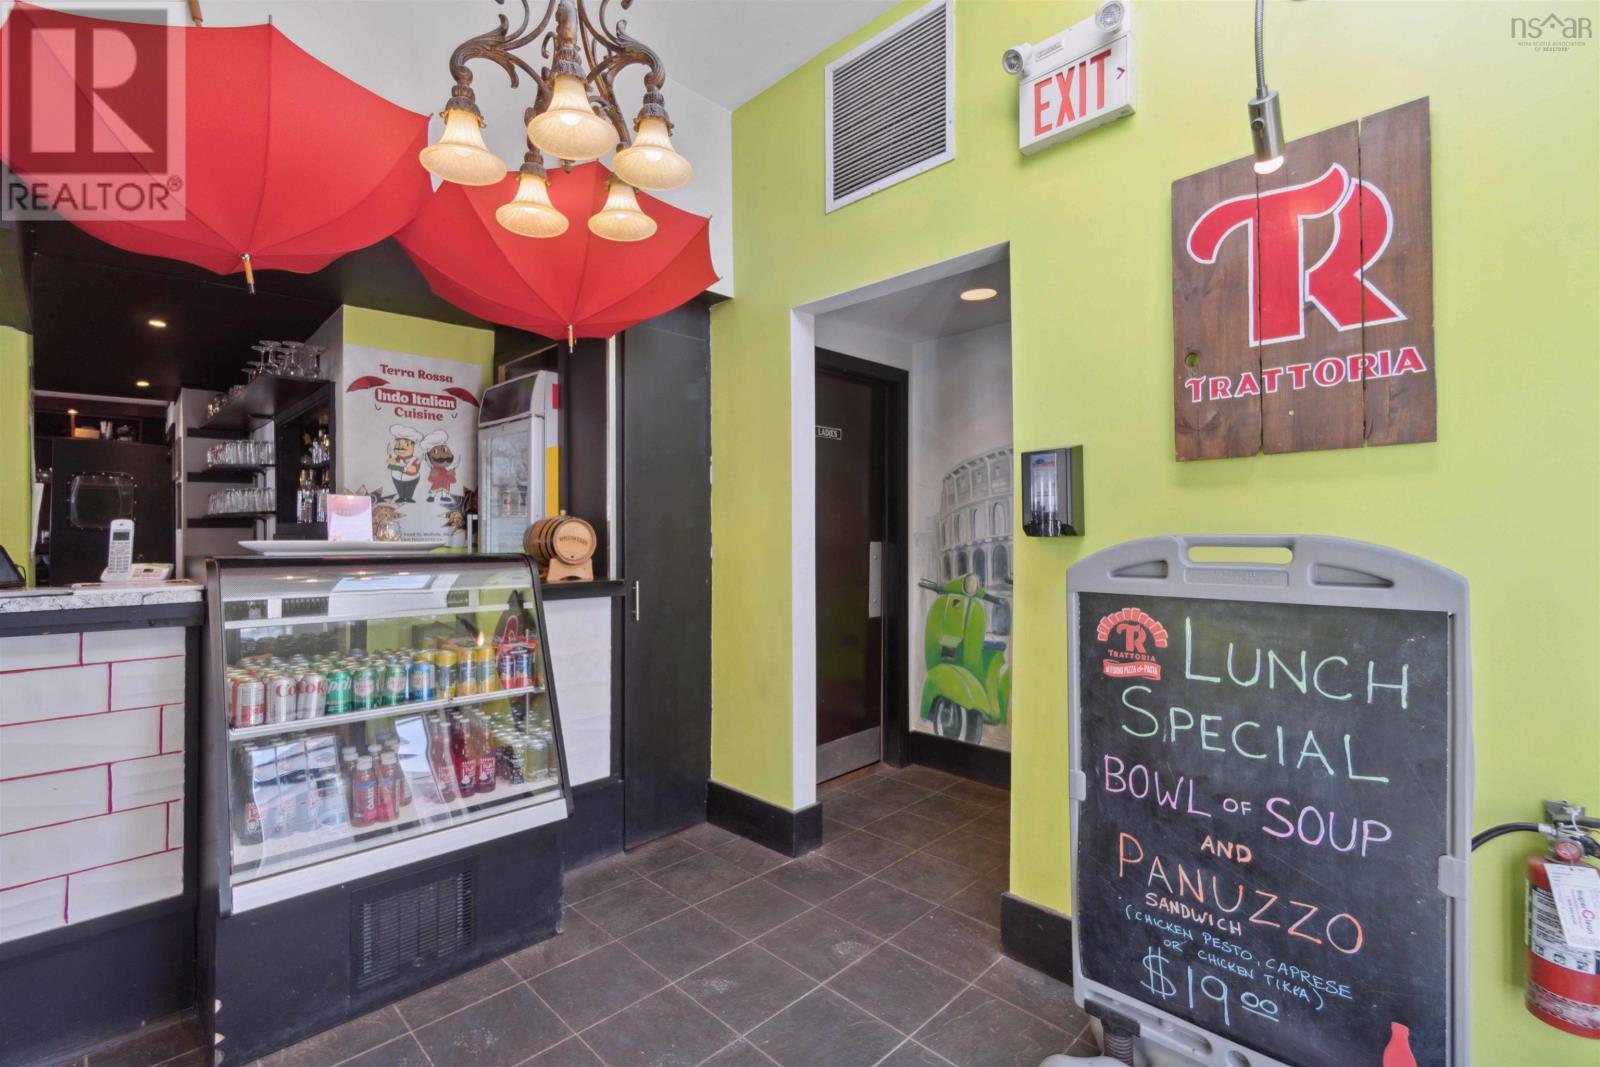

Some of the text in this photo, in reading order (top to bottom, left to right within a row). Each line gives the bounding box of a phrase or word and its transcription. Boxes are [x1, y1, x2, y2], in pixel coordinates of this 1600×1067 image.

[1033, 48, 1112, 137] EXIT
[379, 363, 454, 383] Terra Rossa
[1185, 346, 1428, 403] TRATTORIA
[377, 388, 455, 409] Indo Italian
[394, 406, 444, 422] Cuisine
[817, 428, 838, 438] LADIES
[1107, 648, 1157, 662] TRATTORIA
[1184, 615, 1409, 710] LUNCH
[1121, 684, 1390, 784] SPECIAL
[1103, 753, 1393, 858] BOWL OF SOUP
[1200, 834, 1253, 863] AND
[1118, 831, 1365, 955] PANUZZO
[1144, 891, 1243, 937] SANDWICH
[1163, 938, 1184, 952] OR
[1197, 948, 1255, 980] CHICKEN
[1265, 957, 1354, 1000] CAPRESE
